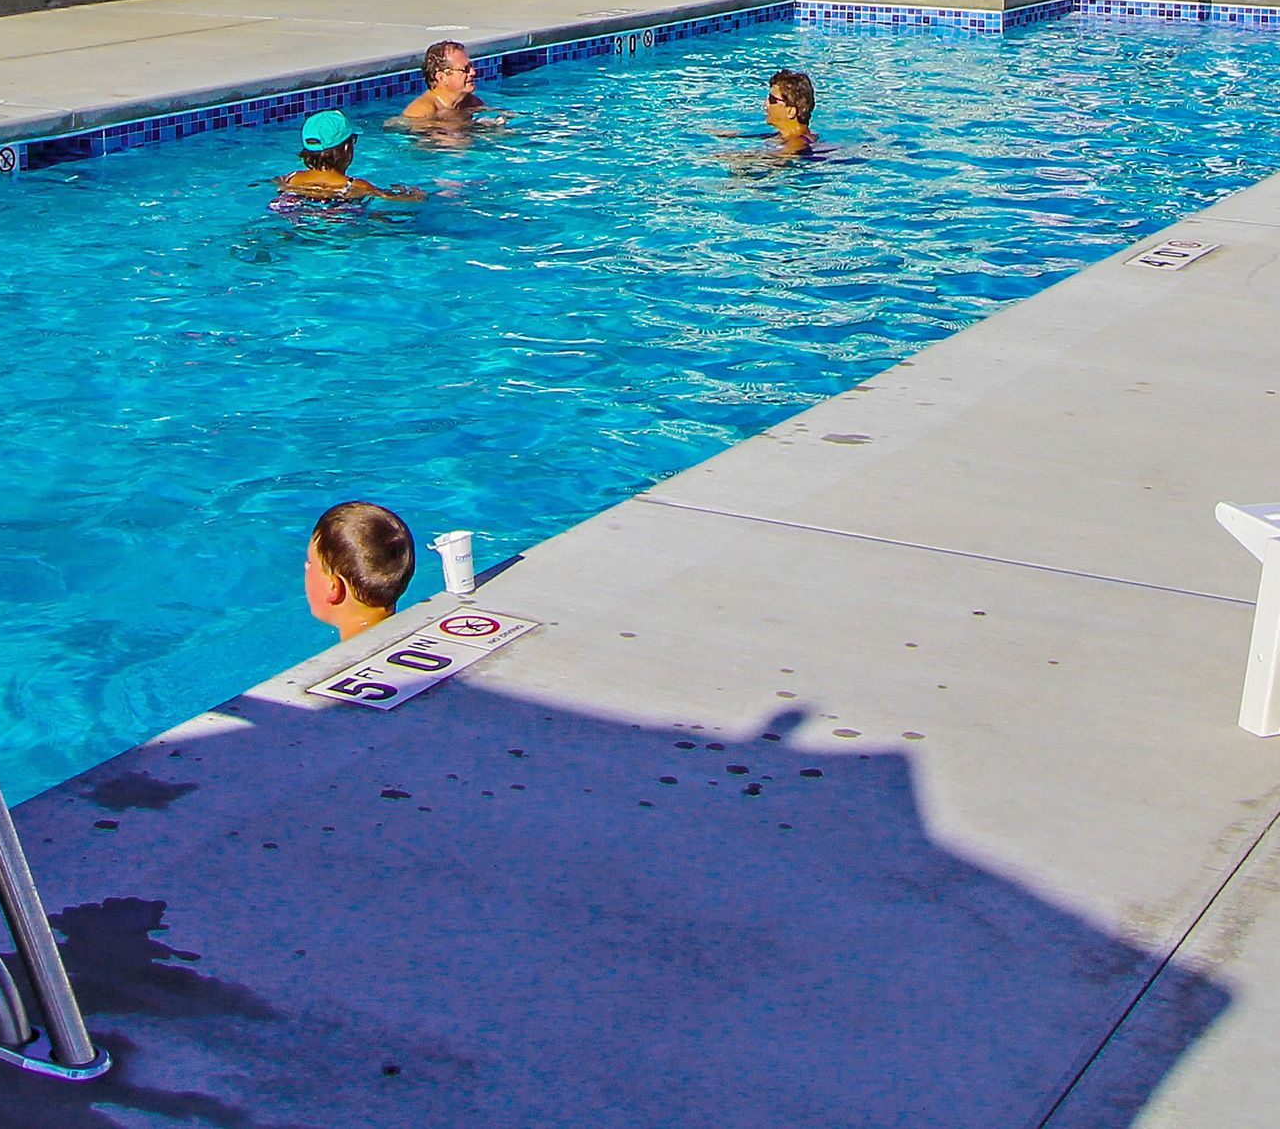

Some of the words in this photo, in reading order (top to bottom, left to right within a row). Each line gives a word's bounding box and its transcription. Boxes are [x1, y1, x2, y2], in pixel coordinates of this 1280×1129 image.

[616, 37, 623, 54] 3
[407, 638, 439, 651] IN
[387, 650, 452, 672] 0
[355, 666, 385, 680] FT
[327, 677, 398, 701] 5
